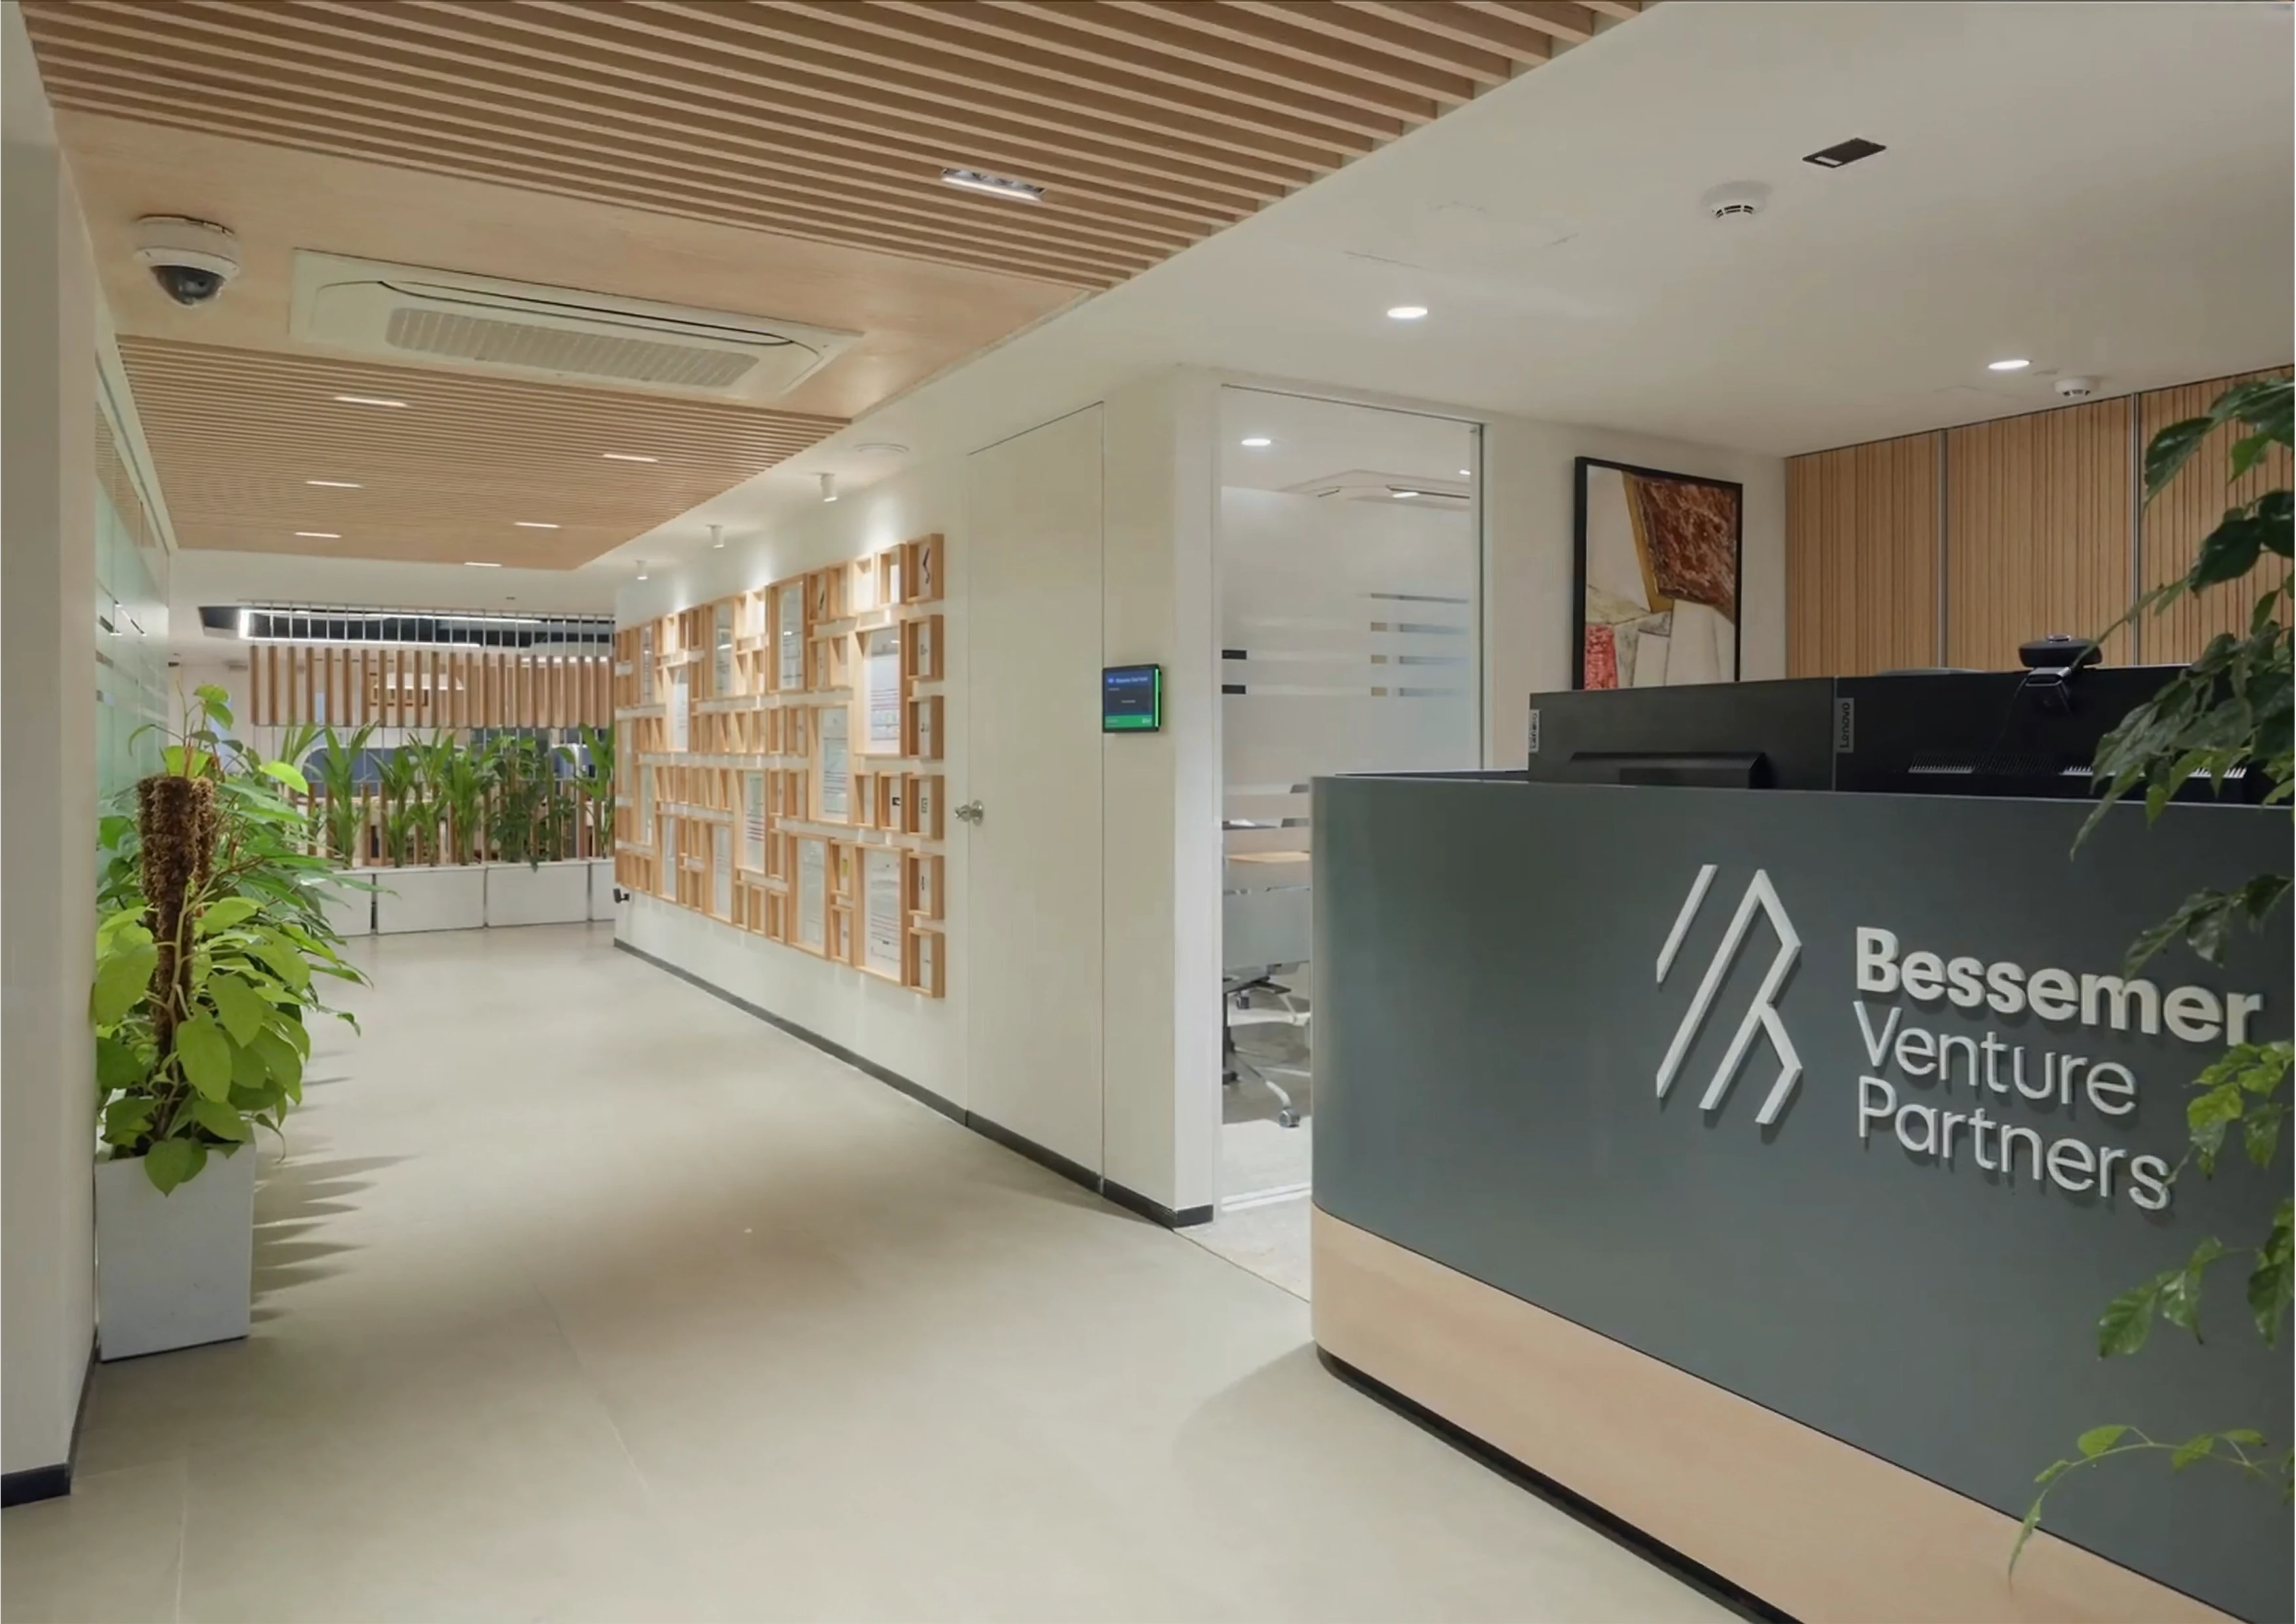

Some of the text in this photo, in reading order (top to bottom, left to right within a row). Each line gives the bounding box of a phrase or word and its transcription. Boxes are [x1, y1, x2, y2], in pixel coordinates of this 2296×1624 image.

[1839, 702, 1850, 748] Lenovo
[1857, 926, 2263, 1046] Bessemer
[1853, 1001, 2137, 1115] Venture
[1858, 1075, 2171, 1210] Partners
